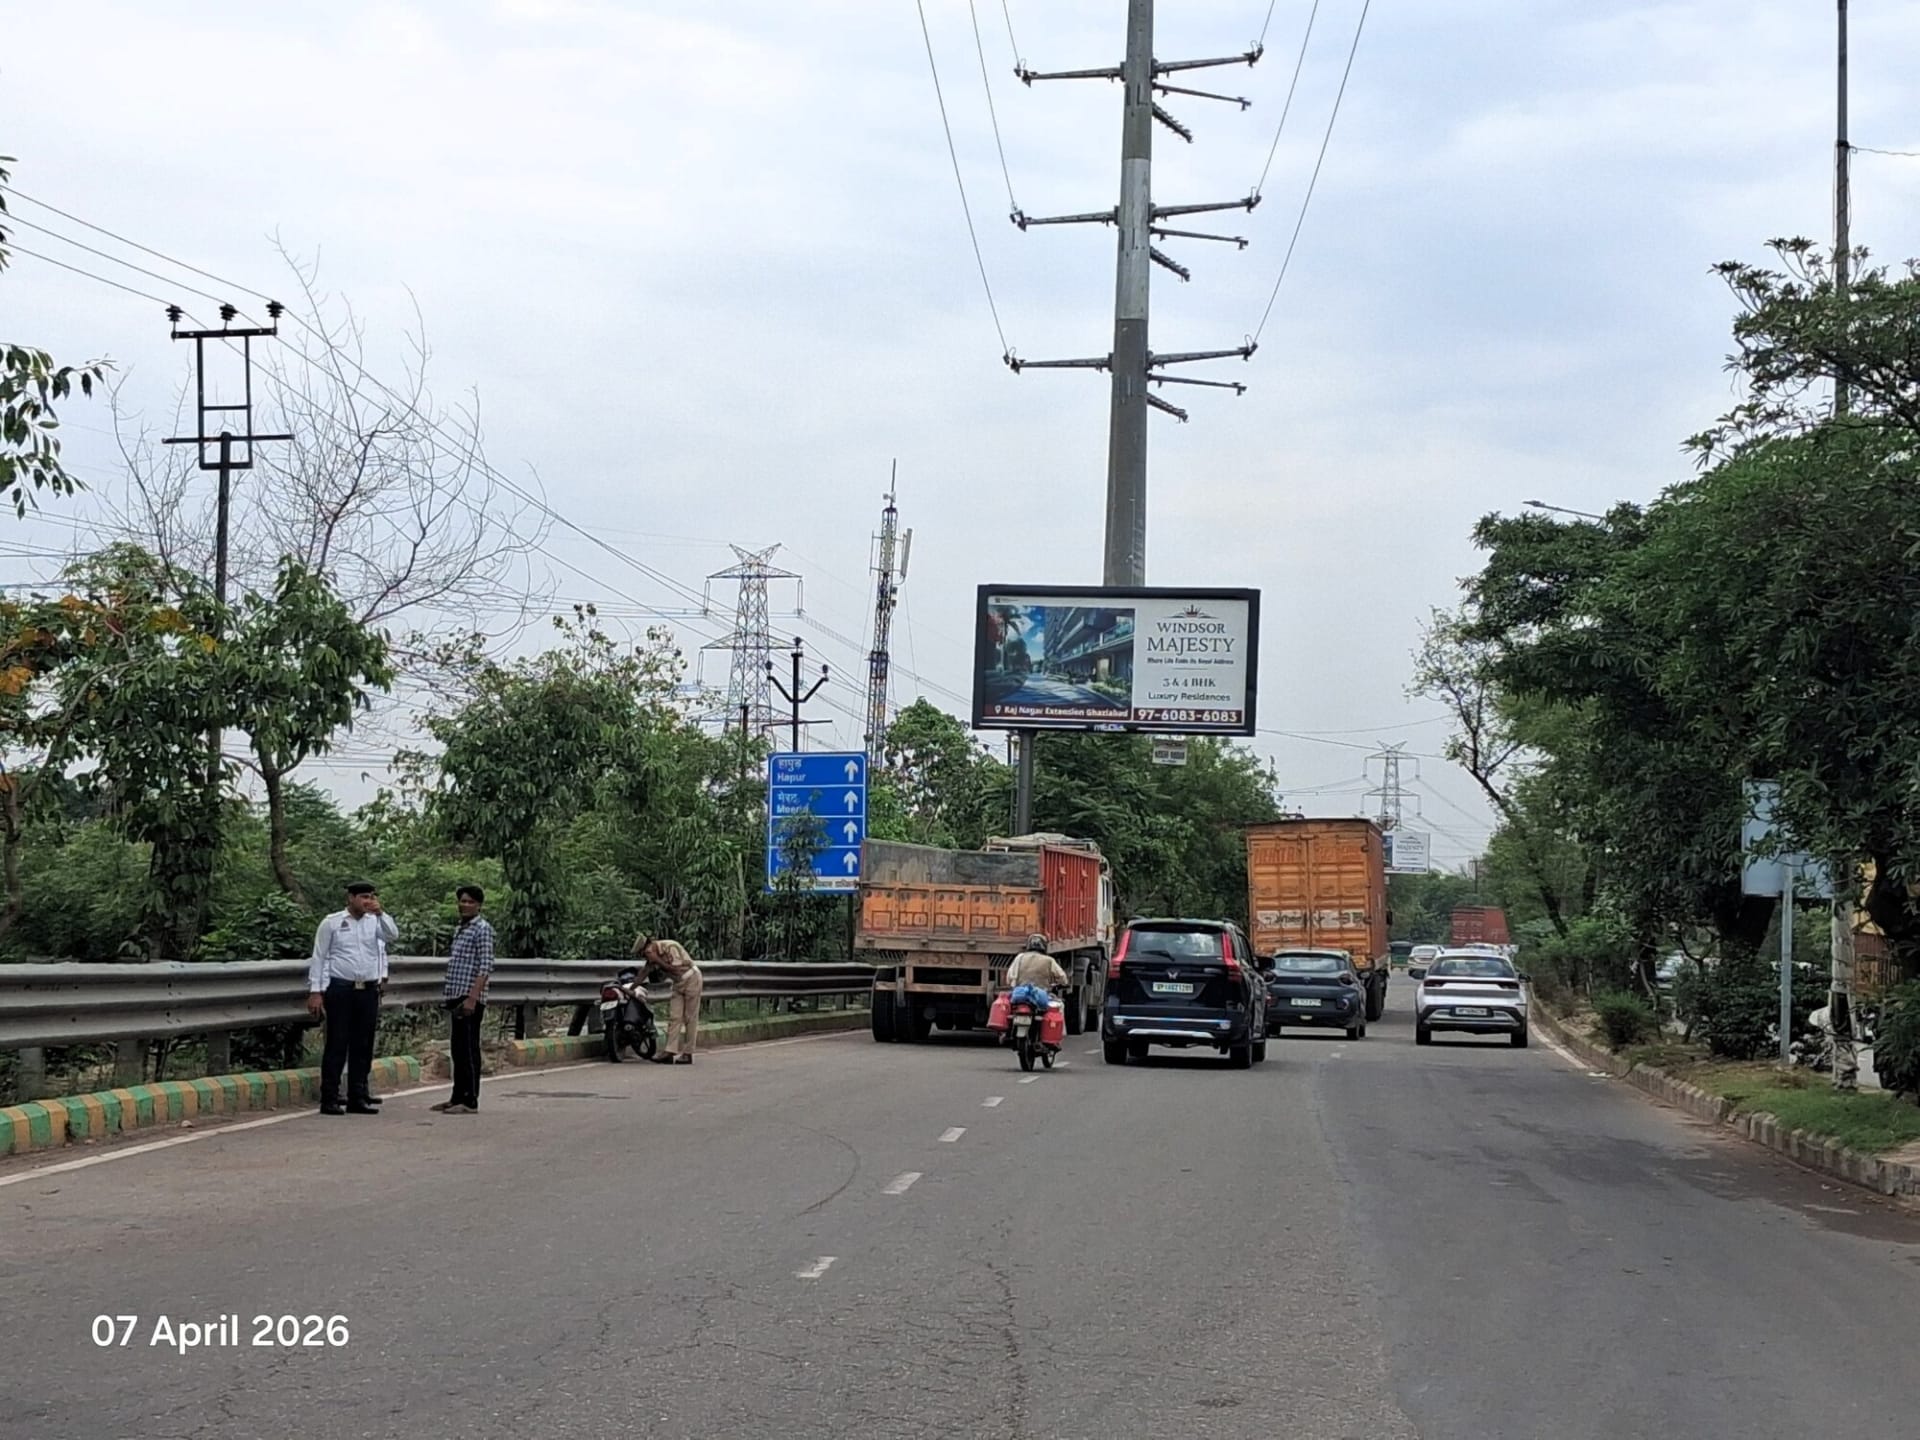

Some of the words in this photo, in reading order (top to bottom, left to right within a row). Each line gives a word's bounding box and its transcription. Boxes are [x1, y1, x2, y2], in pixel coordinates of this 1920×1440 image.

[1157, 622, 1226, 634] WINDSOR
[1147, 637, 1235, 656] MAJESTY
[1191, 678, 1216, 687] BHK
[1148, 692, 1178, 702] Luxury
[1181, 693, 1231, 702] Residences
[1004, 705, 1018, 716] Raj
[1019, 706, 1043, 717] Nagar
[1045, 708, 1084, 716] Extension
[1086, 709, 1128, 717] Ghaziabad
[1138, 709, 1238, 722] 97-6083-6083
[777, 773, 807, 784] Hapur
